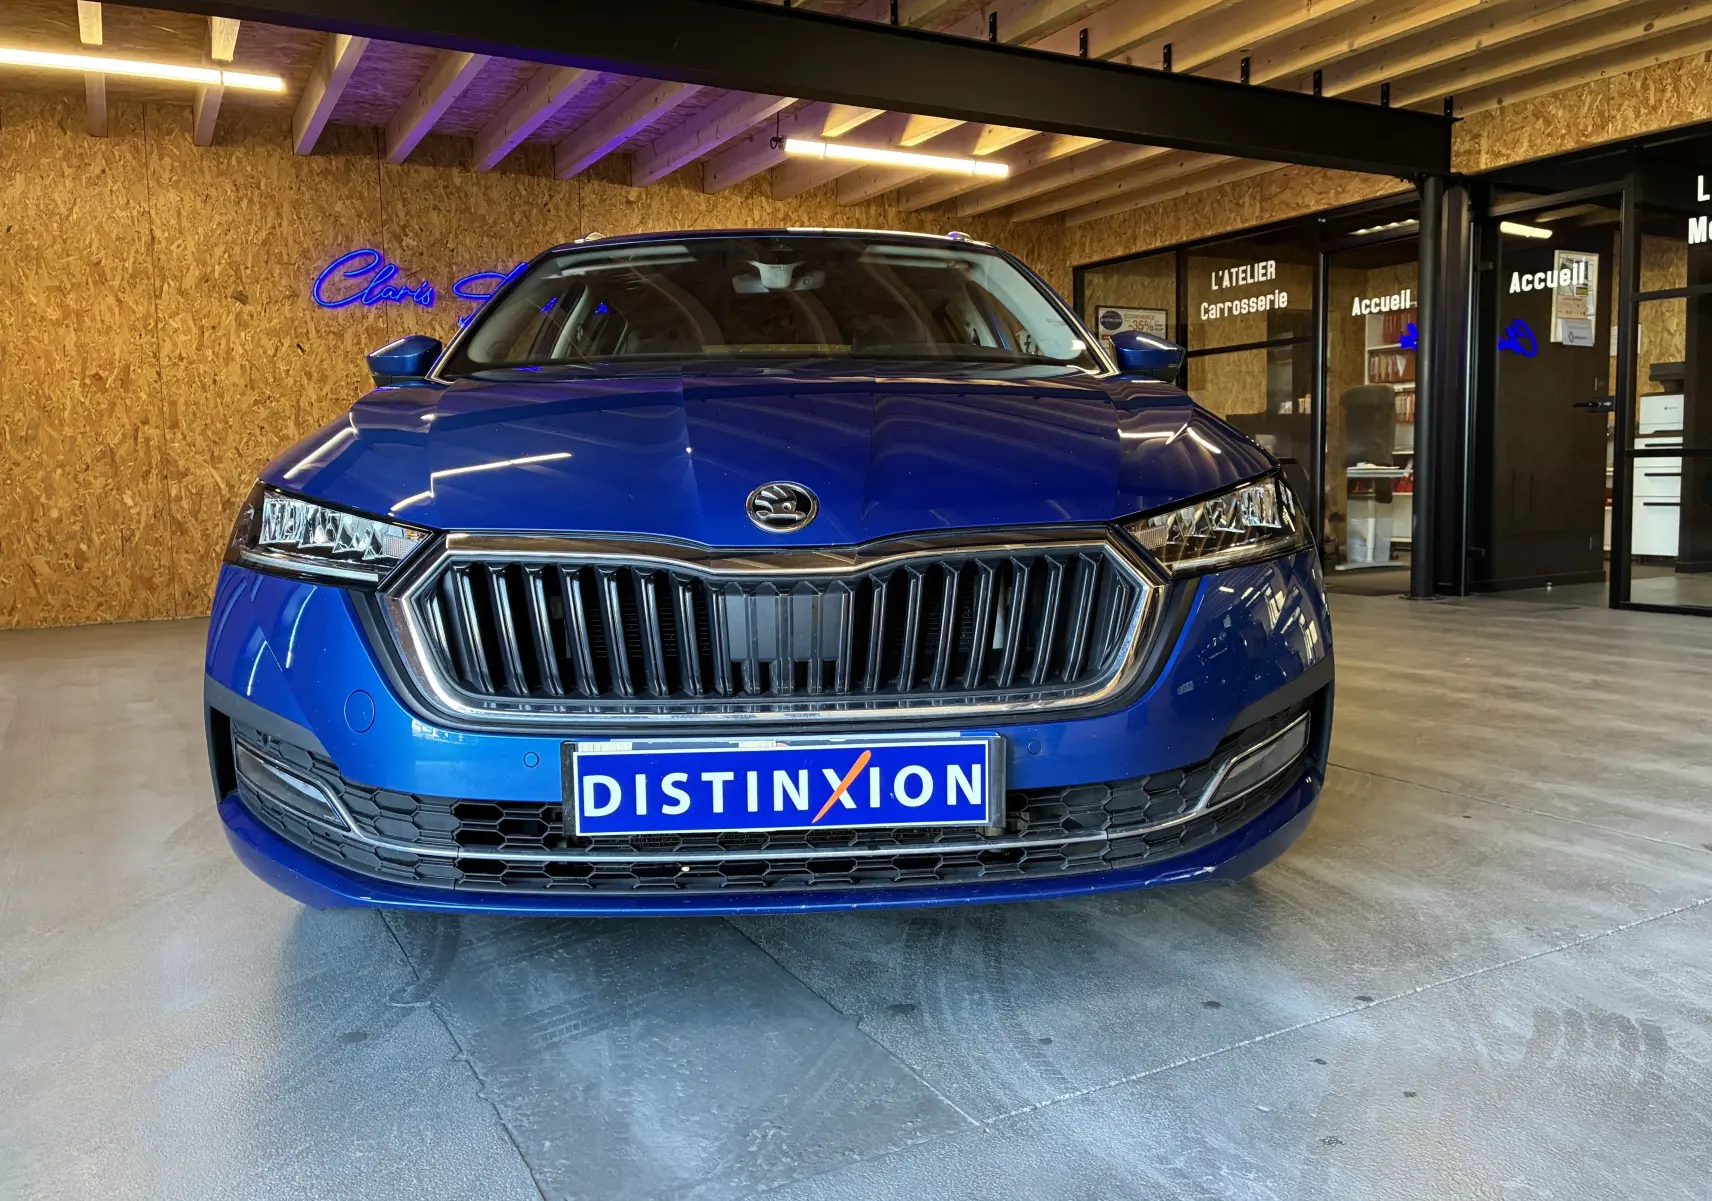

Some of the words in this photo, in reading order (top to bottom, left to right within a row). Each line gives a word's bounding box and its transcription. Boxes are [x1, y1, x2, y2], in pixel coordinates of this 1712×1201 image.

[313, 248, 434, 307] Claris
[1211, 260, 1276, 291] L'ATELIER
[1509, 261, 1585, 294] Accueil
[1200, 289, 1288, 320] Carrosserie
[1351, 289, 1411, 317] Accueil
[581, 750, 983, 824] DISTINXION
